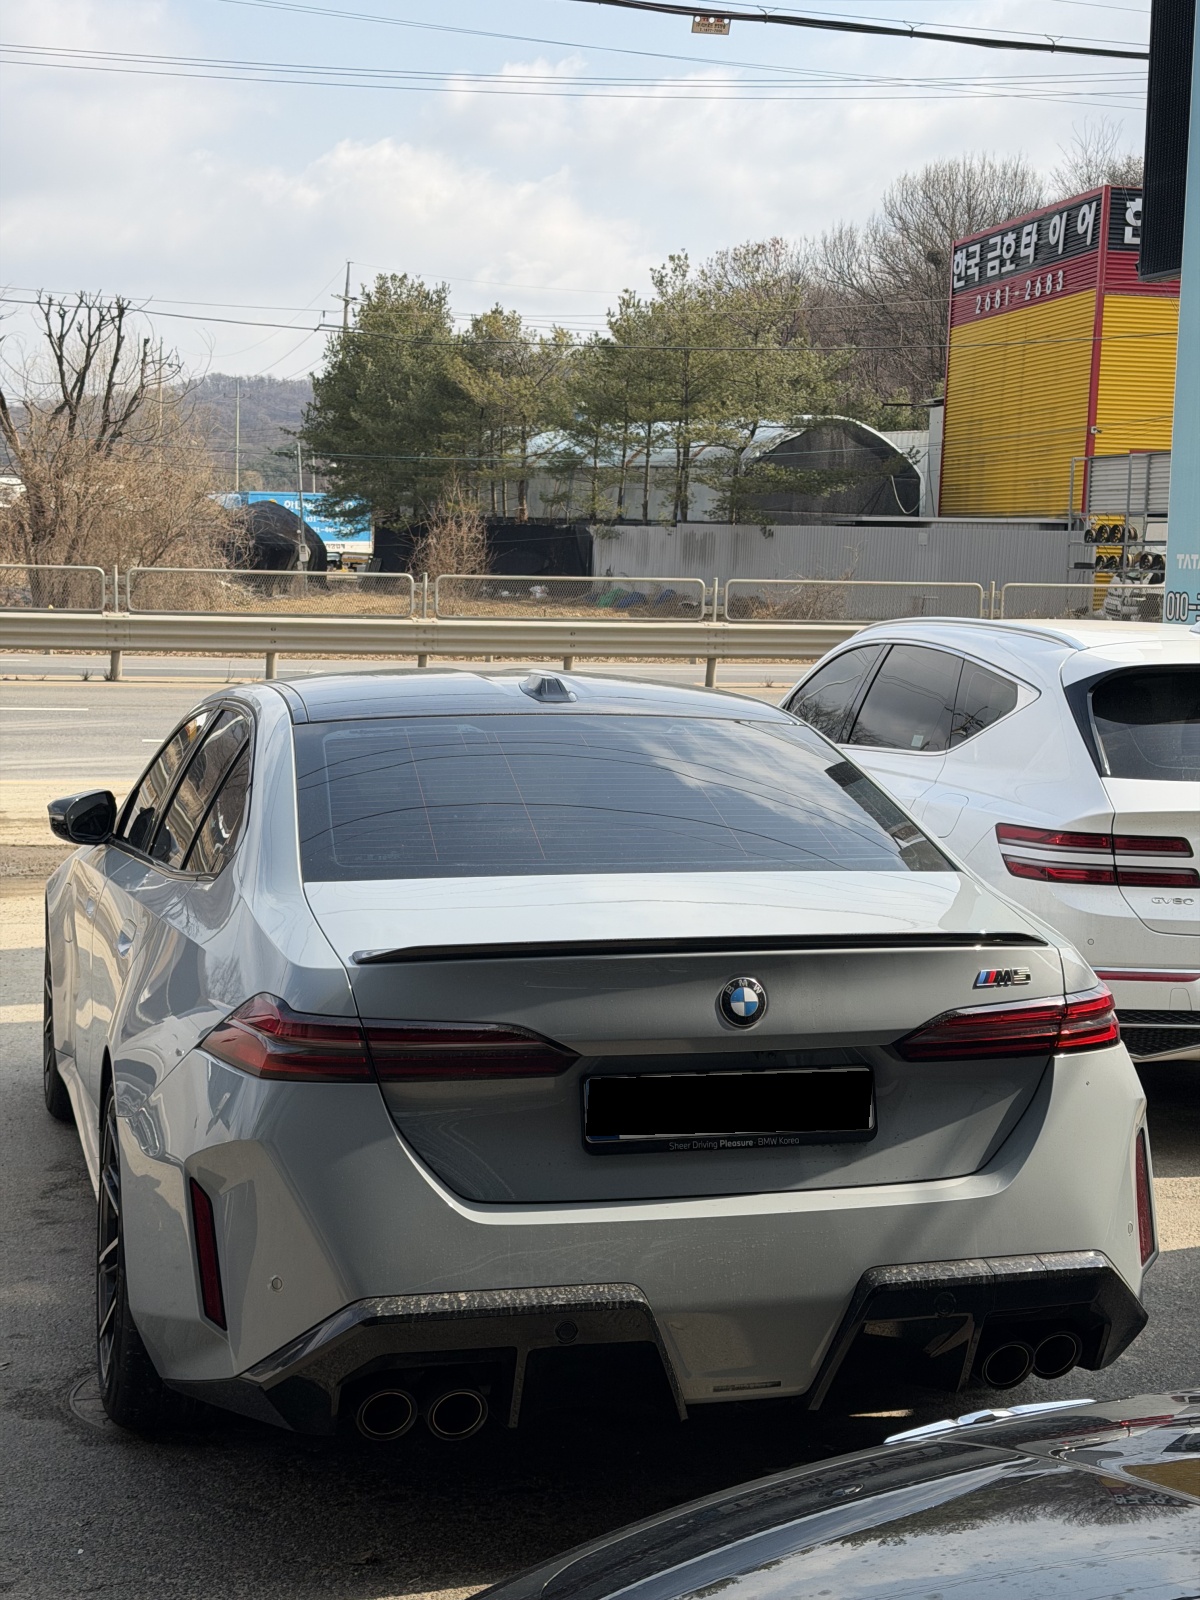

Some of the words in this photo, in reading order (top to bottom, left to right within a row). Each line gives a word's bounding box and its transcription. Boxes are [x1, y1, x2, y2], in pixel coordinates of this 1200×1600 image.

[953, 243, 981, 289] 한국
[975, 269, 1064, 314] 2681-2683
[725, 979, 762, 995] BMW
[669, 1141, 691, 1150] Sheer
[692, 1140, 718, 1150] Driving
[719, 1139, 754, 1148] Pleasure
[757, 1137, 777, 1146] BMW
[778, 1136, 800, 1145] Korea
